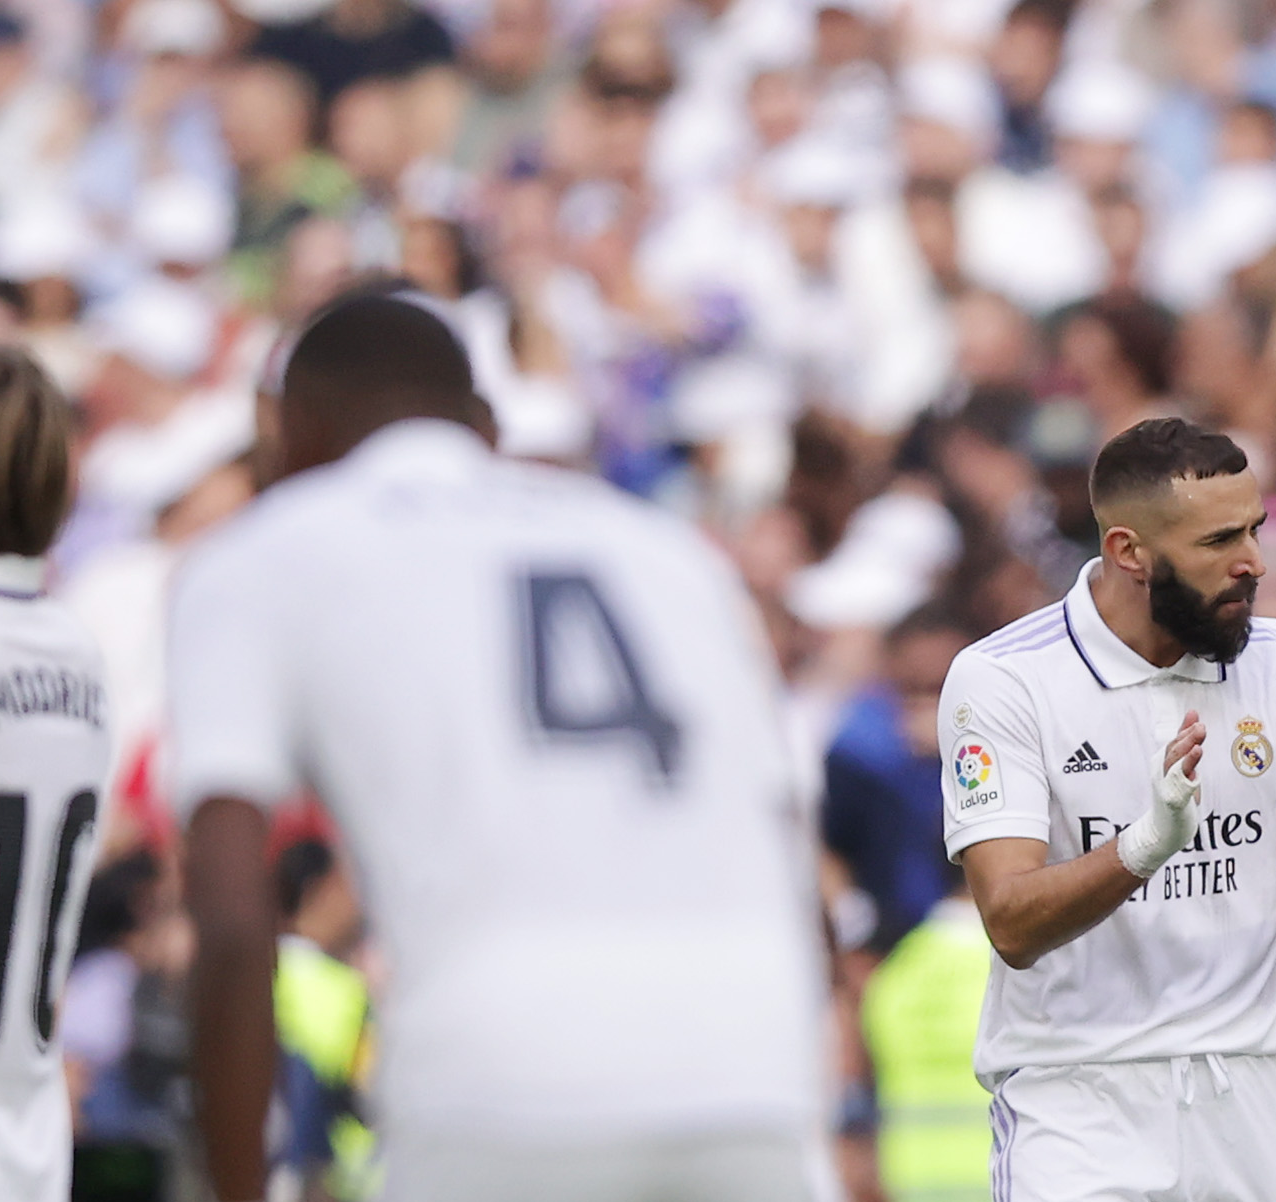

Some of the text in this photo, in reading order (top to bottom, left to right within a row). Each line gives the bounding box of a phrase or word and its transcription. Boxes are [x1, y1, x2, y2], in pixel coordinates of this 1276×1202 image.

[513, 566, 685, 784] 4
[1063, 761, 1108, 774] adidas
[1078, 809, 1263, 854] Eates
[1164, 856, 1238, 900] BETTER
